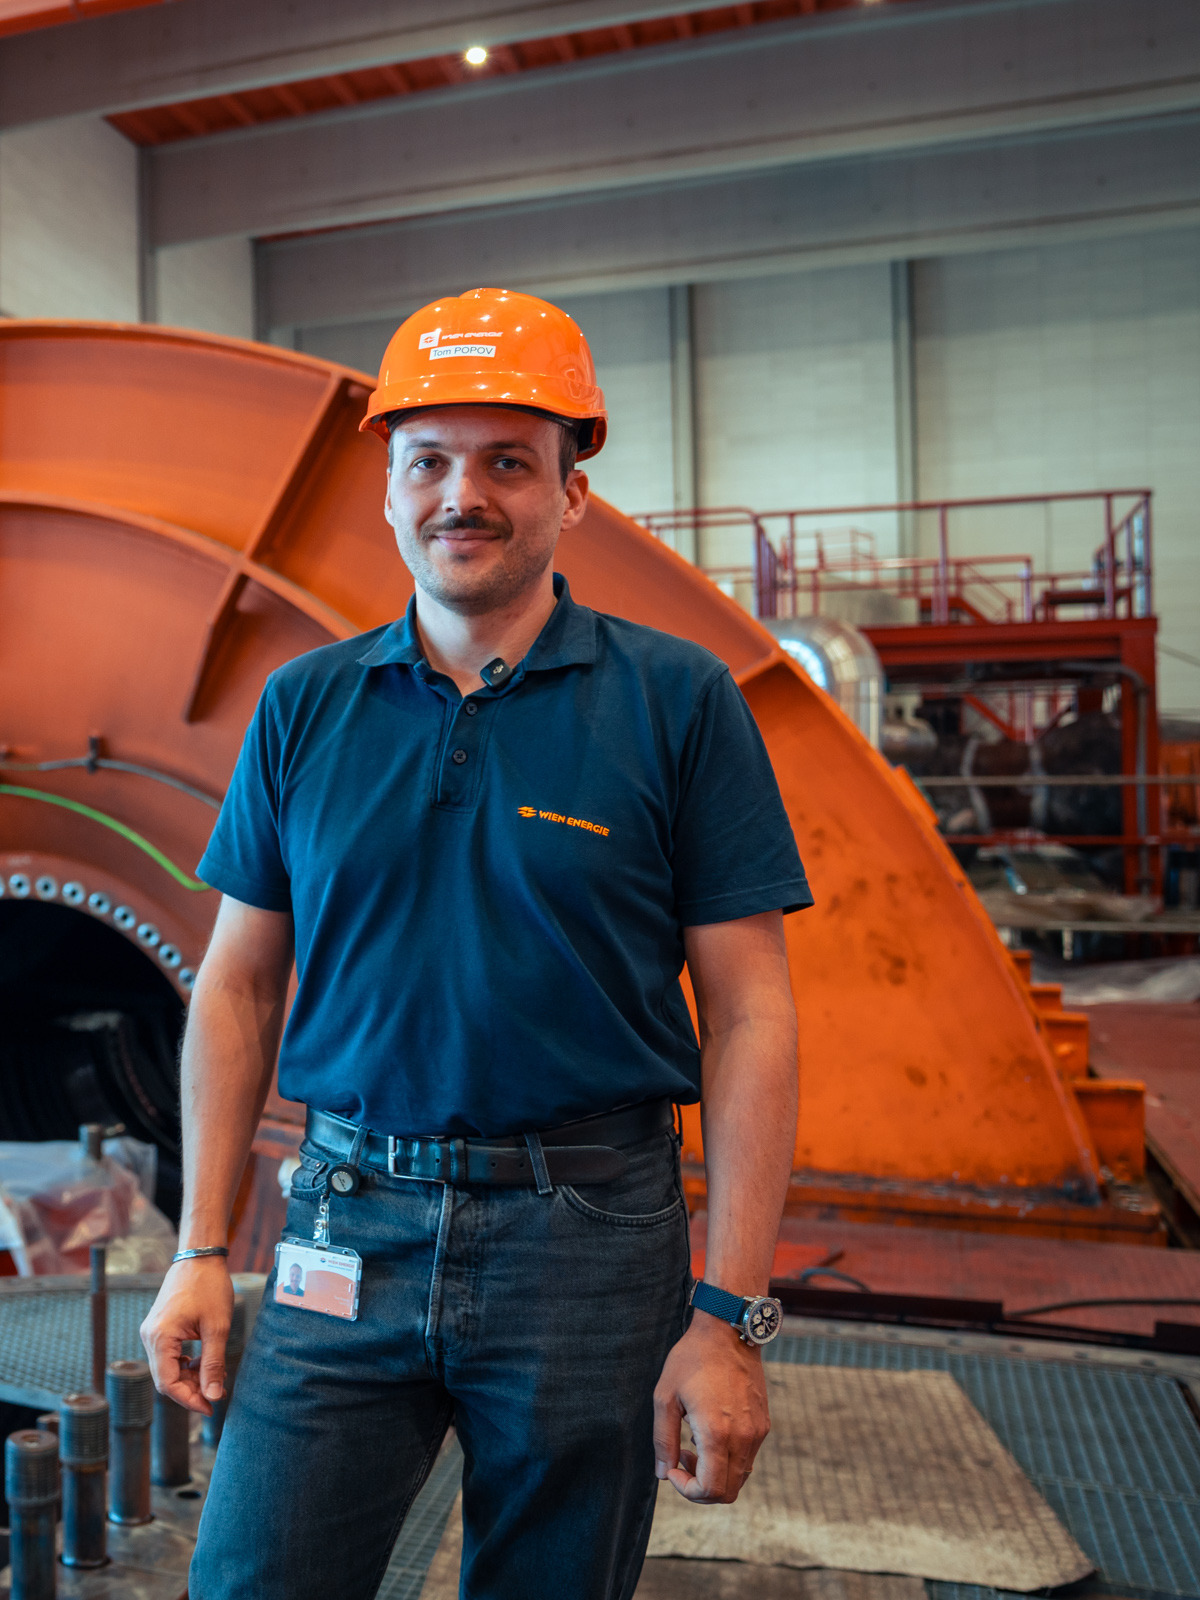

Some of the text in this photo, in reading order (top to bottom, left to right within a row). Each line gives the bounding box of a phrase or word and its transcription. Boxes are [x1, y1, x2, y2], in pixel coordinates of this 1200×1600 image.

[433, 346, 494, 357] Tom POPOV
[539, 810, 610, 837] WIEN ENERGIE
